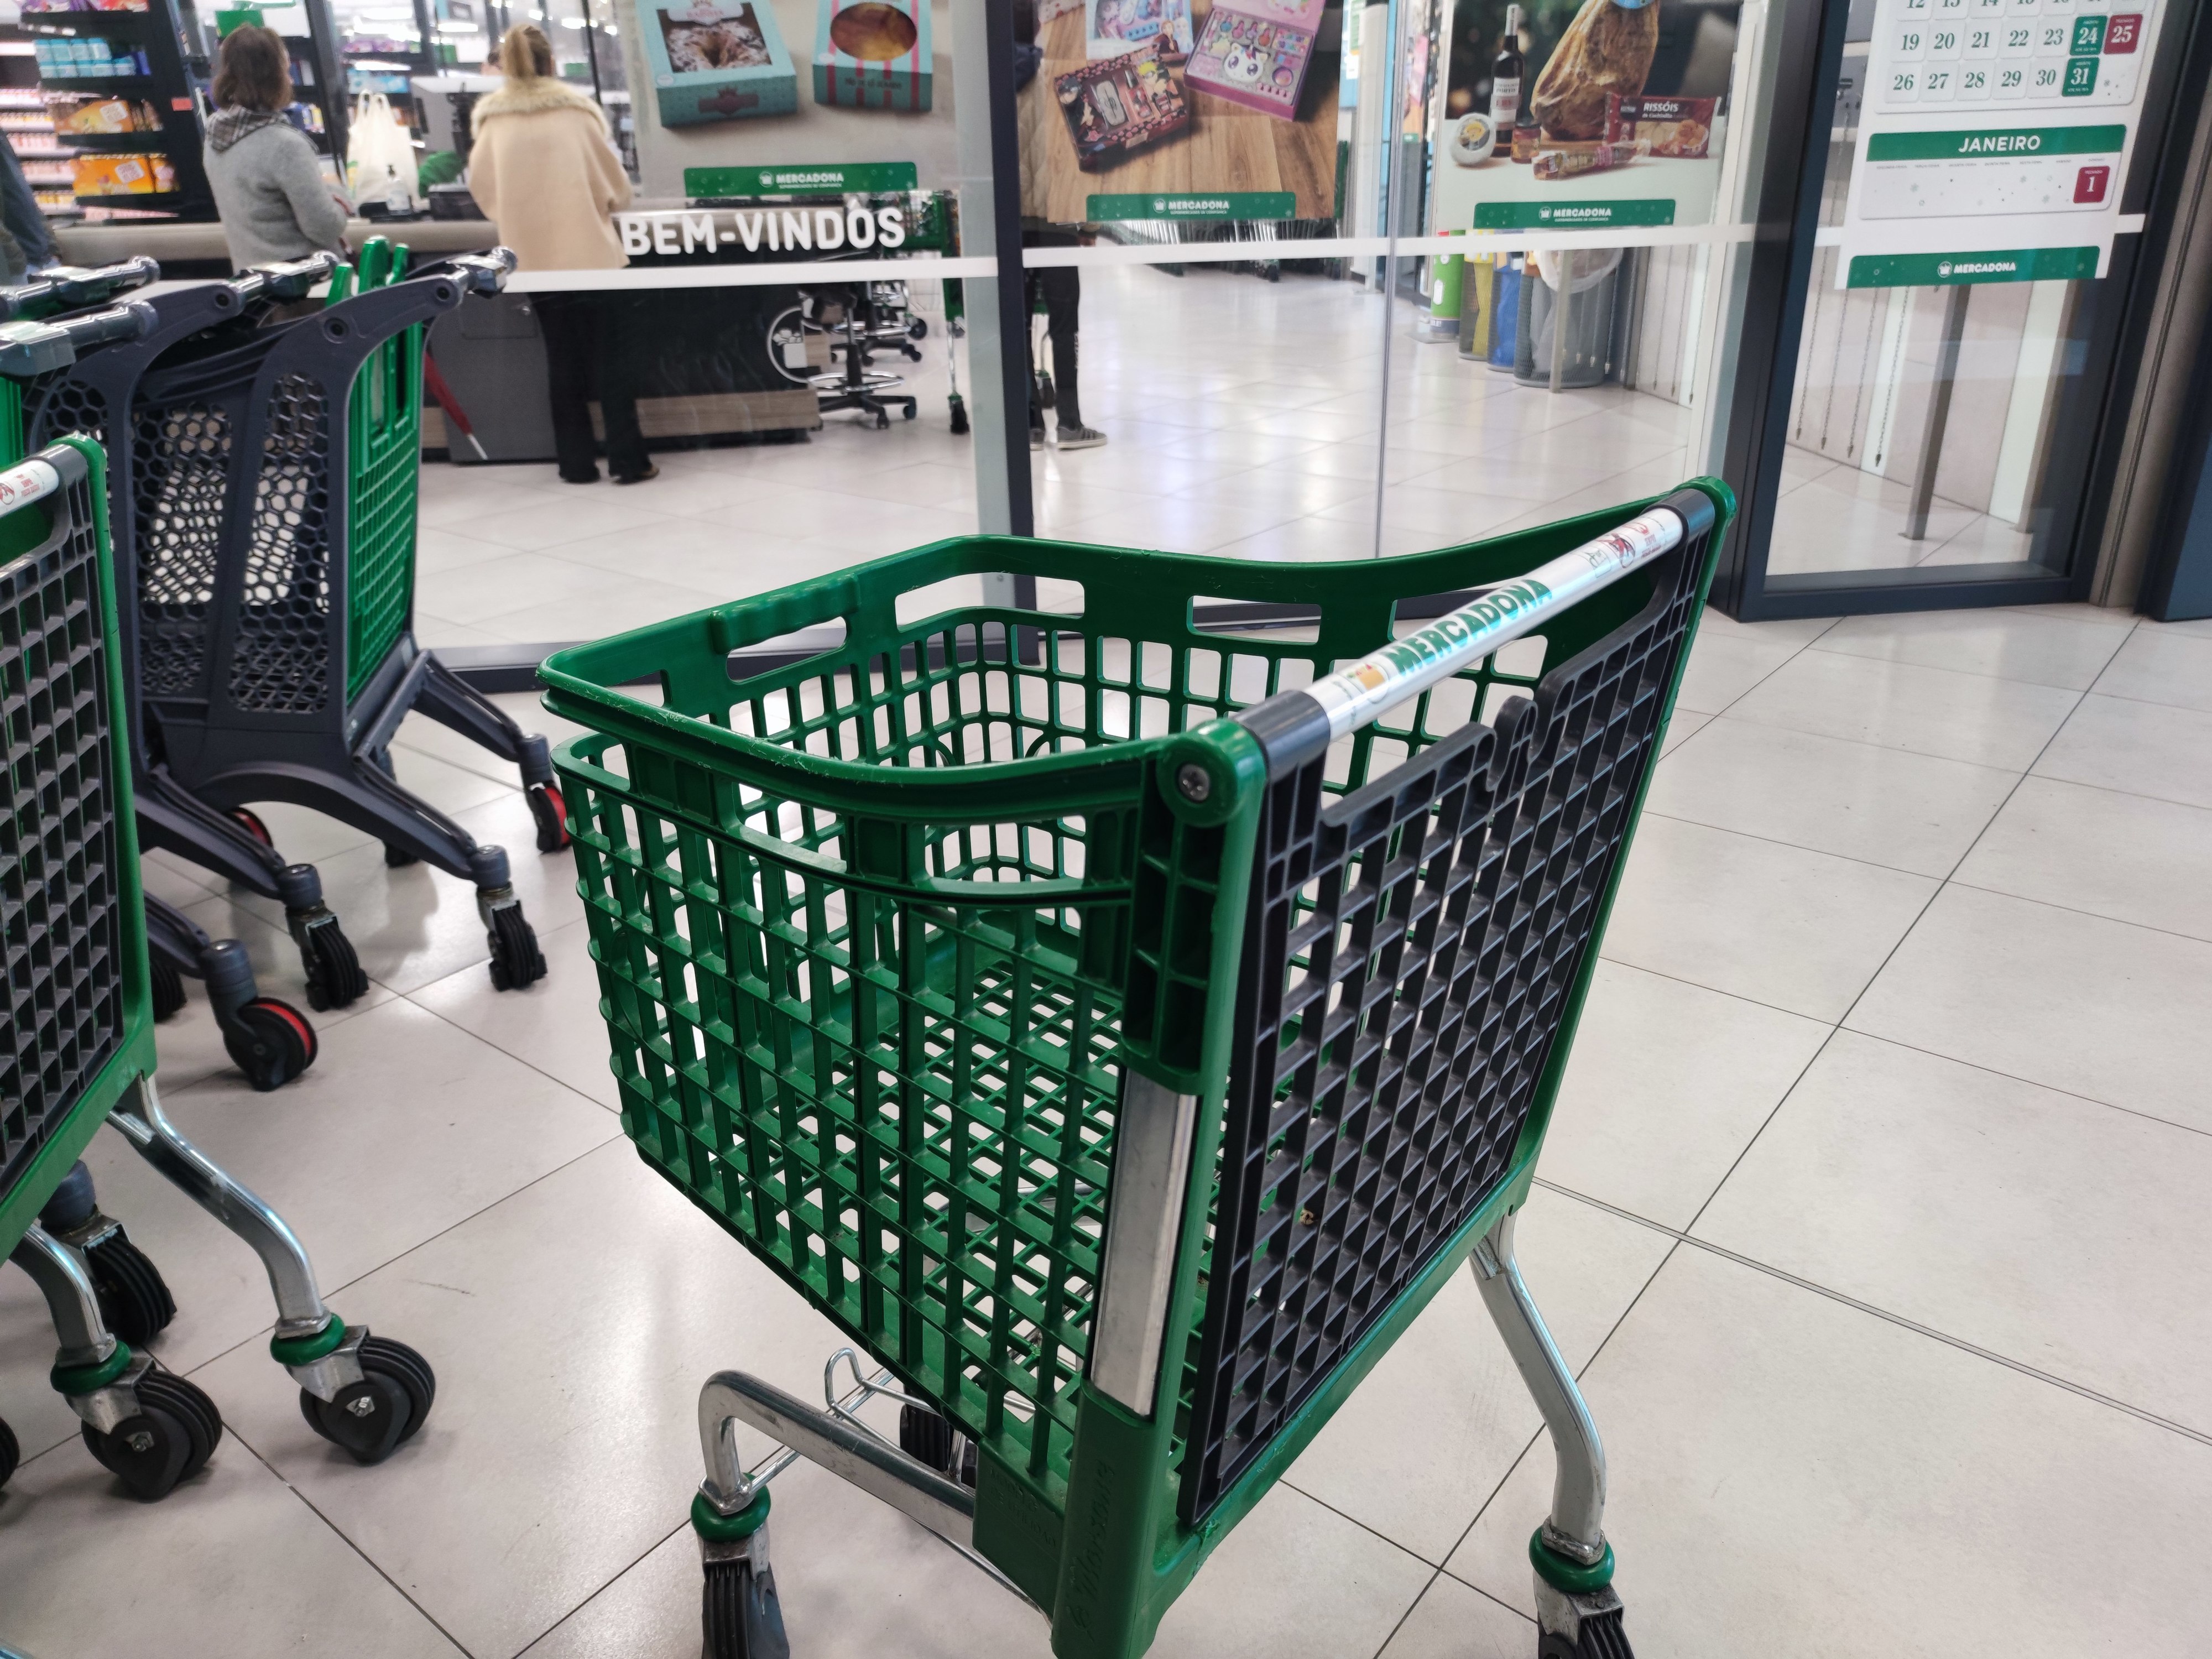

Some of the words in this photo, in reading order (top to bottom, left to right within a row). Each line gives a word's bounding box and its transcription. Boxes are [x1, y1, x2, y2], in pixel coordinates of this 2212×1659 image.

[1901, 34, 1919, 50] 19
[1934, 33, 1955, 49] 20
[1971, 32, 1990, 48] 21
[2008, 30, 2028, 46] 22
[2043, 28, 2063, 45] 23
[2077, 27, 2099, 44] 24
[2110, 25, 2133, 43] 25
[1893, 74, 1914, 90] 26
[1928, 73, 1949, 90] 27
[1964, 71, 1985, 88] 28
[2001, 70, 2022, 87] 29
[2036, 69, 2056, 86] 30
[2070, 67, 2090, 85] 31
[1958, 135, 2041, 153] JANEIRO
[775, 173, 844, 184] MERCADONA
[2086, 175, 2095, 193] 1
[1168, 200, 1230, 210] MERCADONA
[1553, 207, 1612, 218] MERCADONA
[619, 208, 906, 256] BEM-VINDOS
[1953, 262, 2016, 274] MERCADONA
[1379, 579, 1553, 676] MERCADONA
